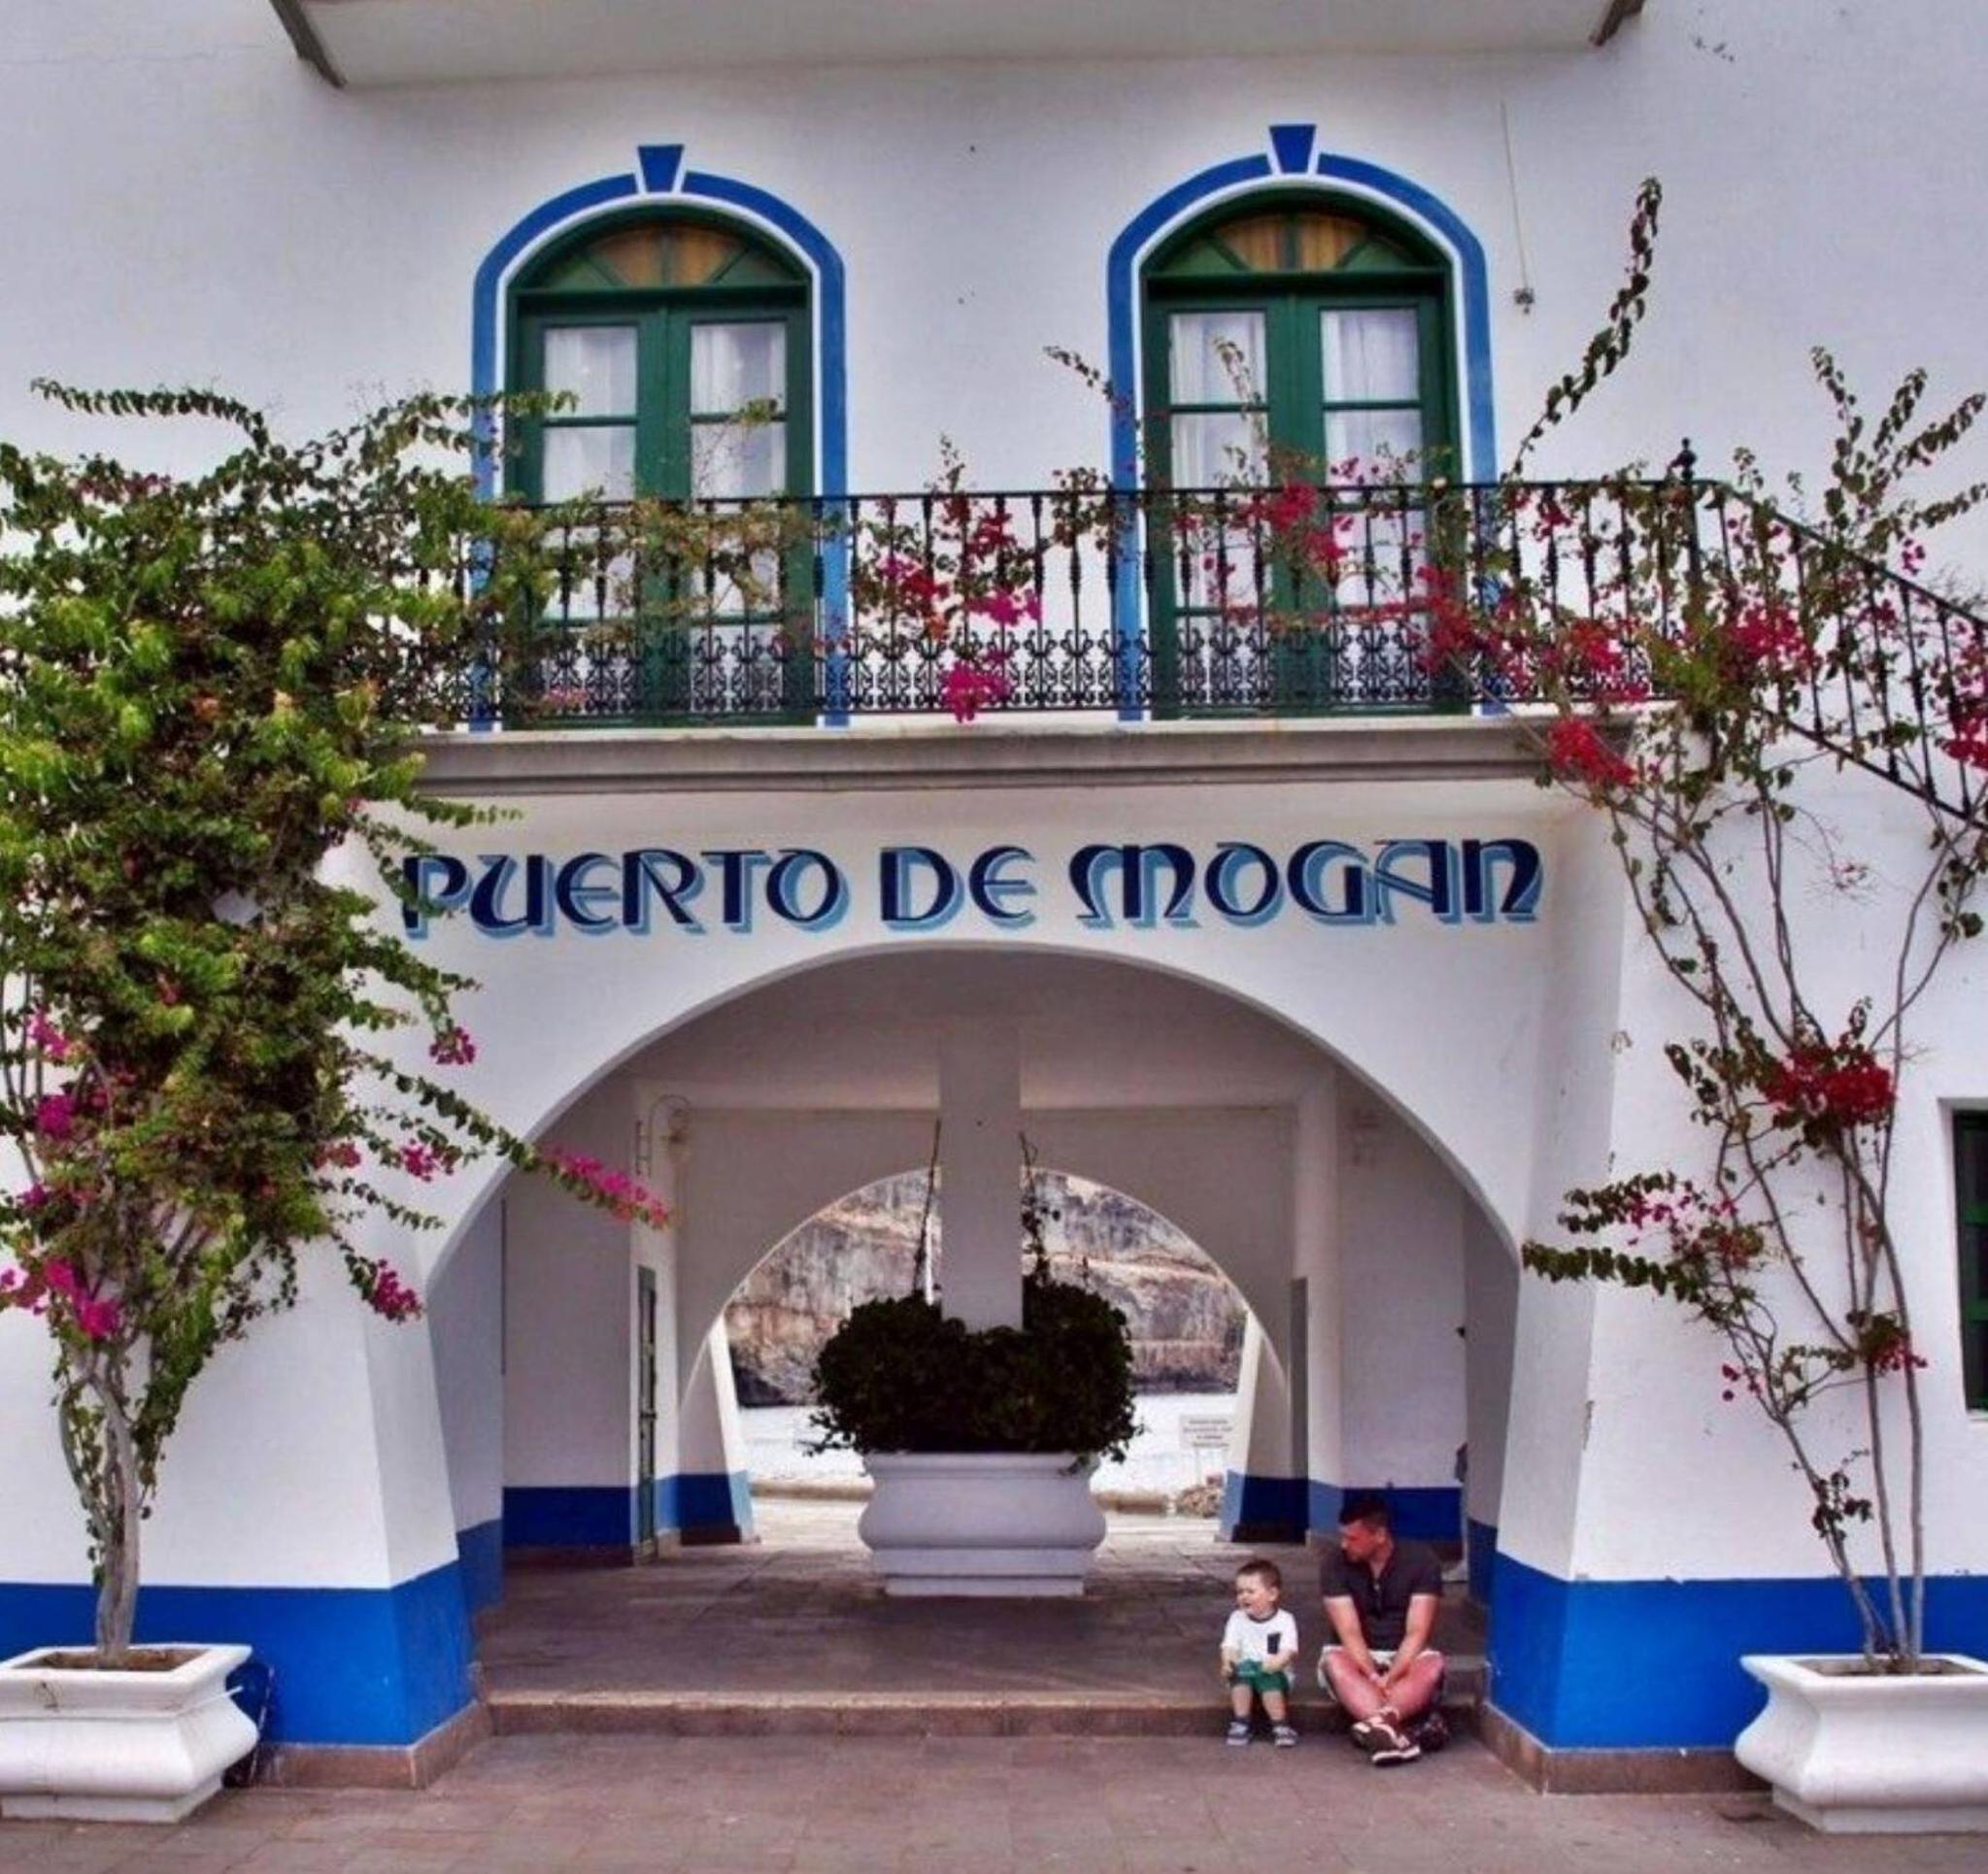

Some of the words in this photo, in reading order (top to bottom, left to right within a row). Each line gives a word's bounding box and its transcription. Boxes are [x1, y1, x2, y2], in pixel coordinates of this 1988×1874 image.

[402, 847, 850, 940] PUERTO
[879, 845, 1038, 932] DE
[1068, 838, 1544, 929] MOGAN
